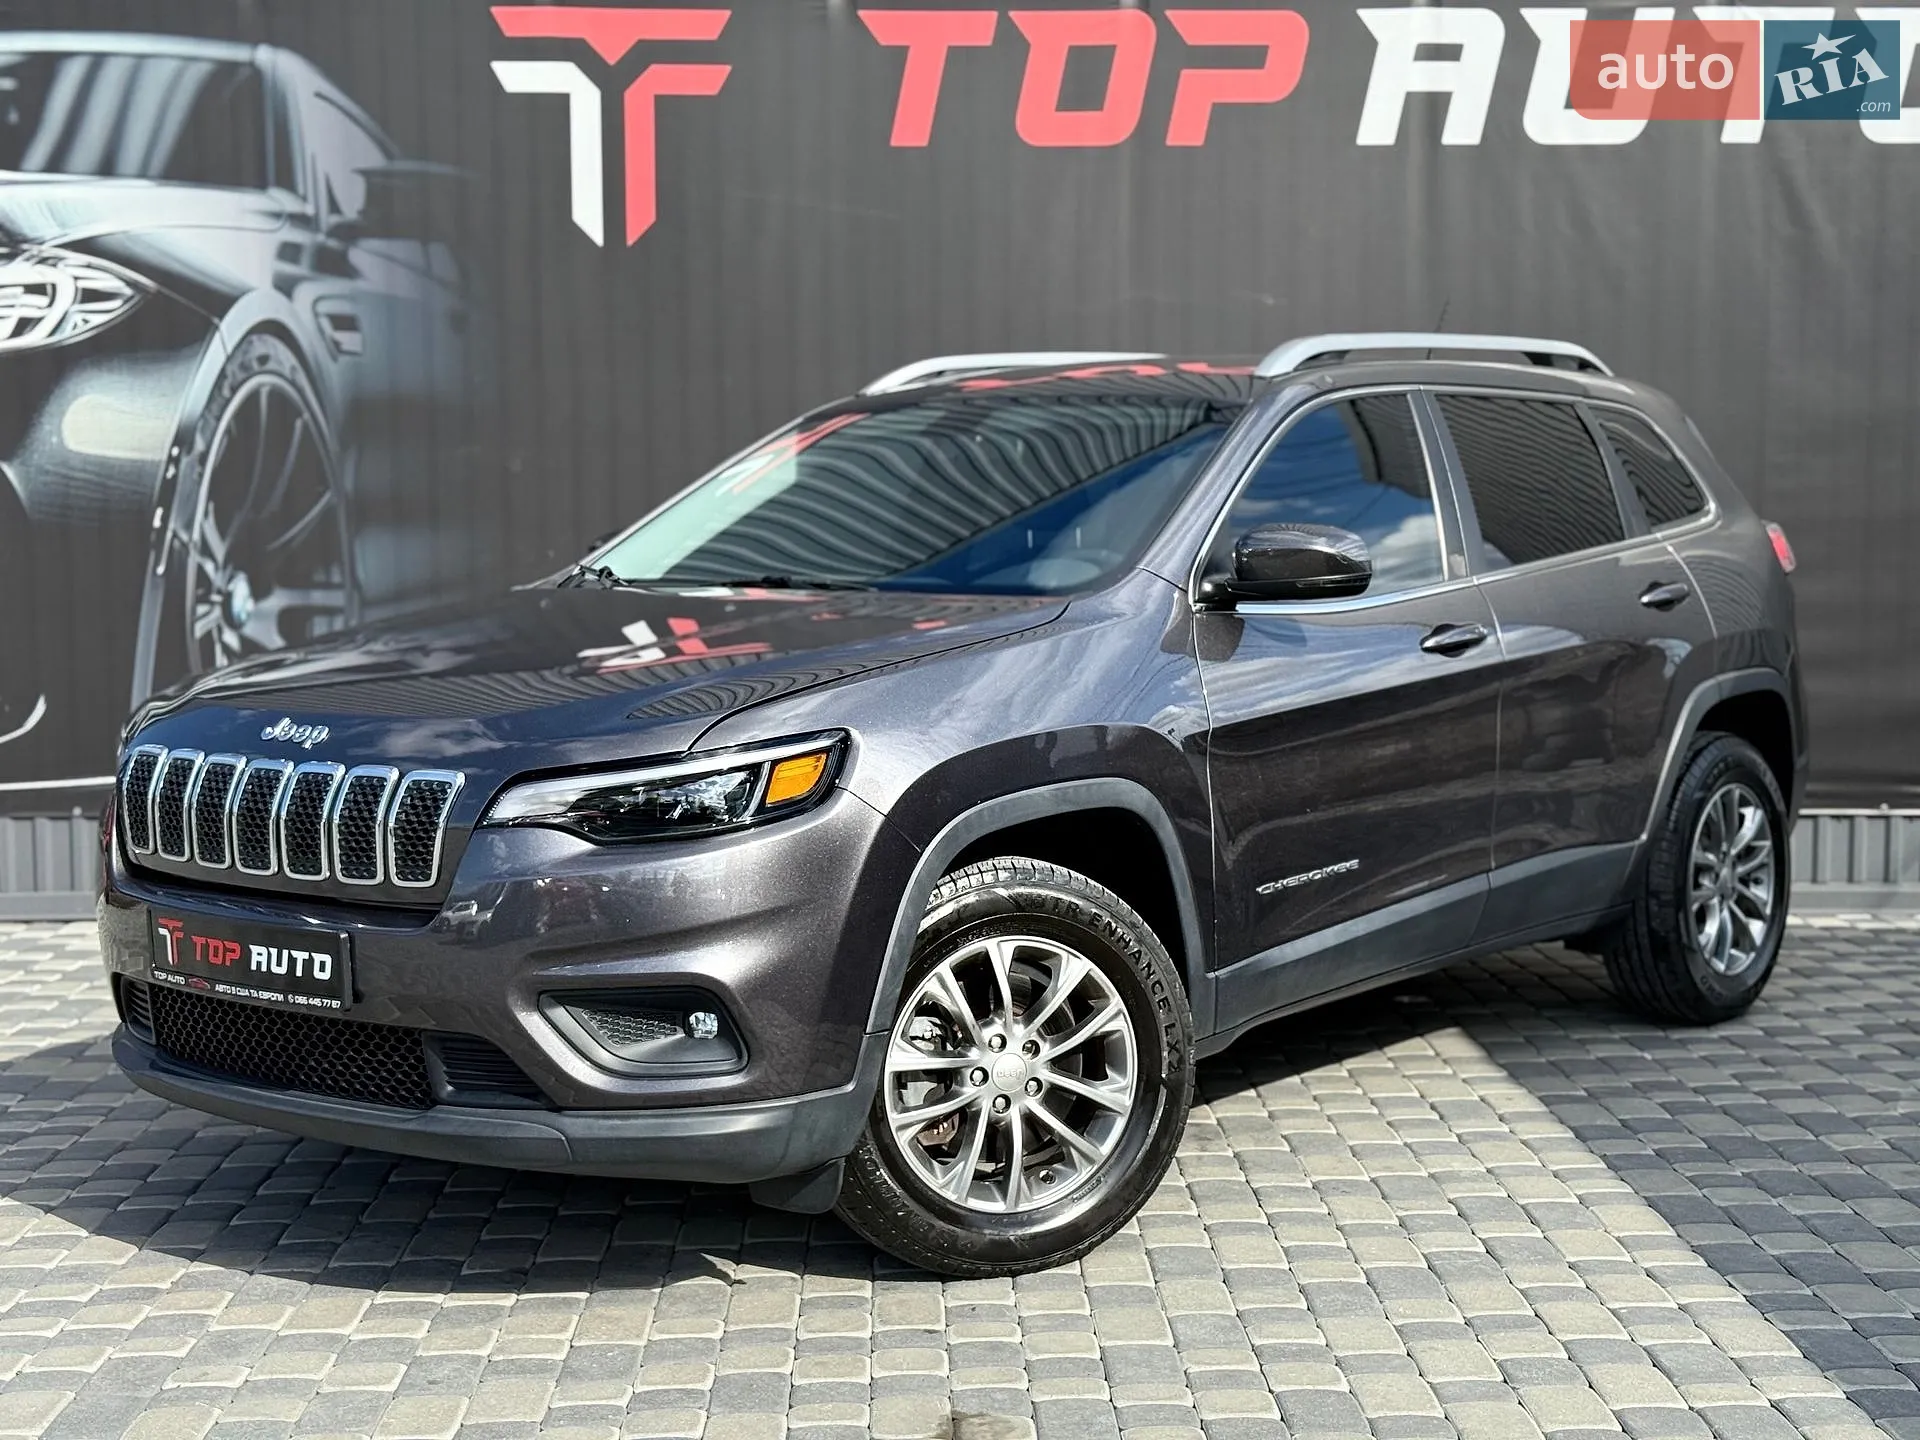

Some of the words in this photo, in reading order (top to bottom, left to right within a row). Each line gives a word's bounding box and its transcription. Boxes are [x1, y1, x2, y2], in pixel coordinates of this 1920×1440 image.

[857, 9, 1309, 147] TOP
[261, 717, 330, 750] Jeep
[1255, 859, 1359, 894] CHEROKEE
[191, 935, 241, 966] TOP
[249, 944, 332, 980] AUTO
[1088, 909, 1171, 1011] ENHANCE
[154, 971, 167, 980] TOP
[168, 974, 185, 985] AUTO
